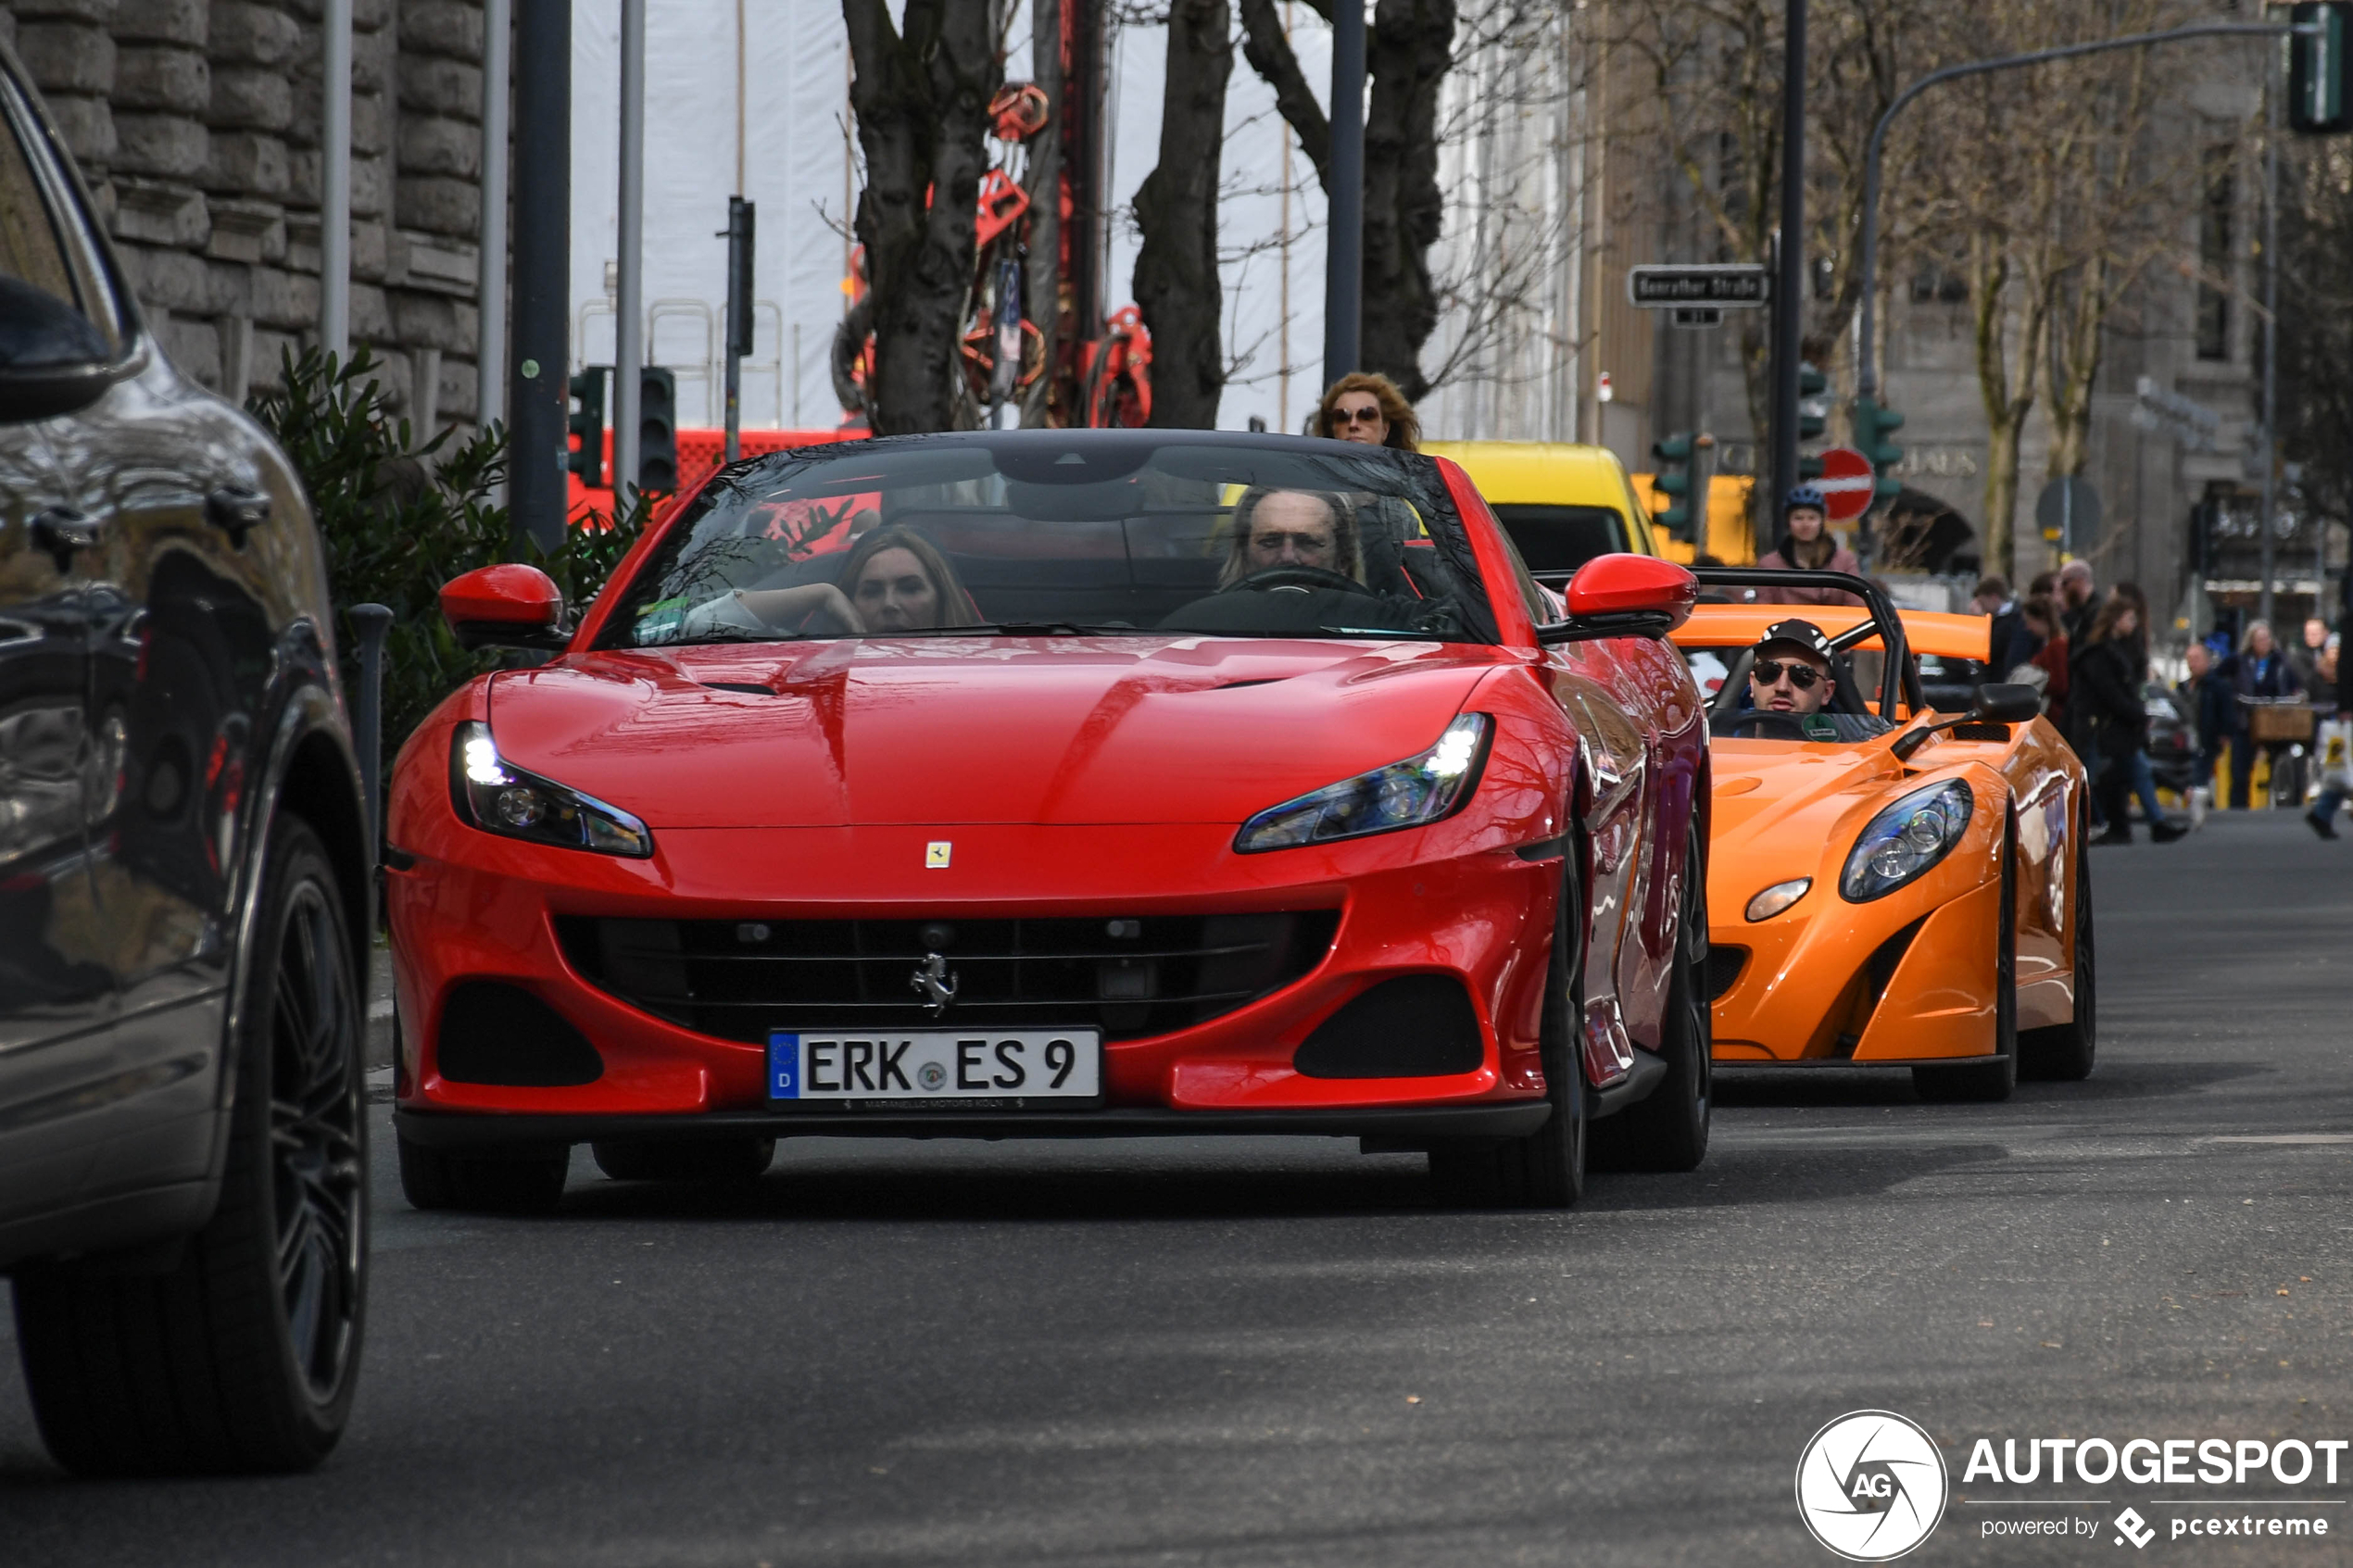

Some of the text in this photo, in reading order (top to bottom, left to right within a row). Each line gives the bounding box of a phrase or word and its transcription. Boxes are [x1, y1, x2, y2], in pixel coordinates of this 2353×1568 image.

[808, 1038, 1076, 1092] ERK ES 9
[778, 1073, 790, 1088] D
[865, 1098, 1003, 1110] MARIANELLO MOTORS KÖLN
